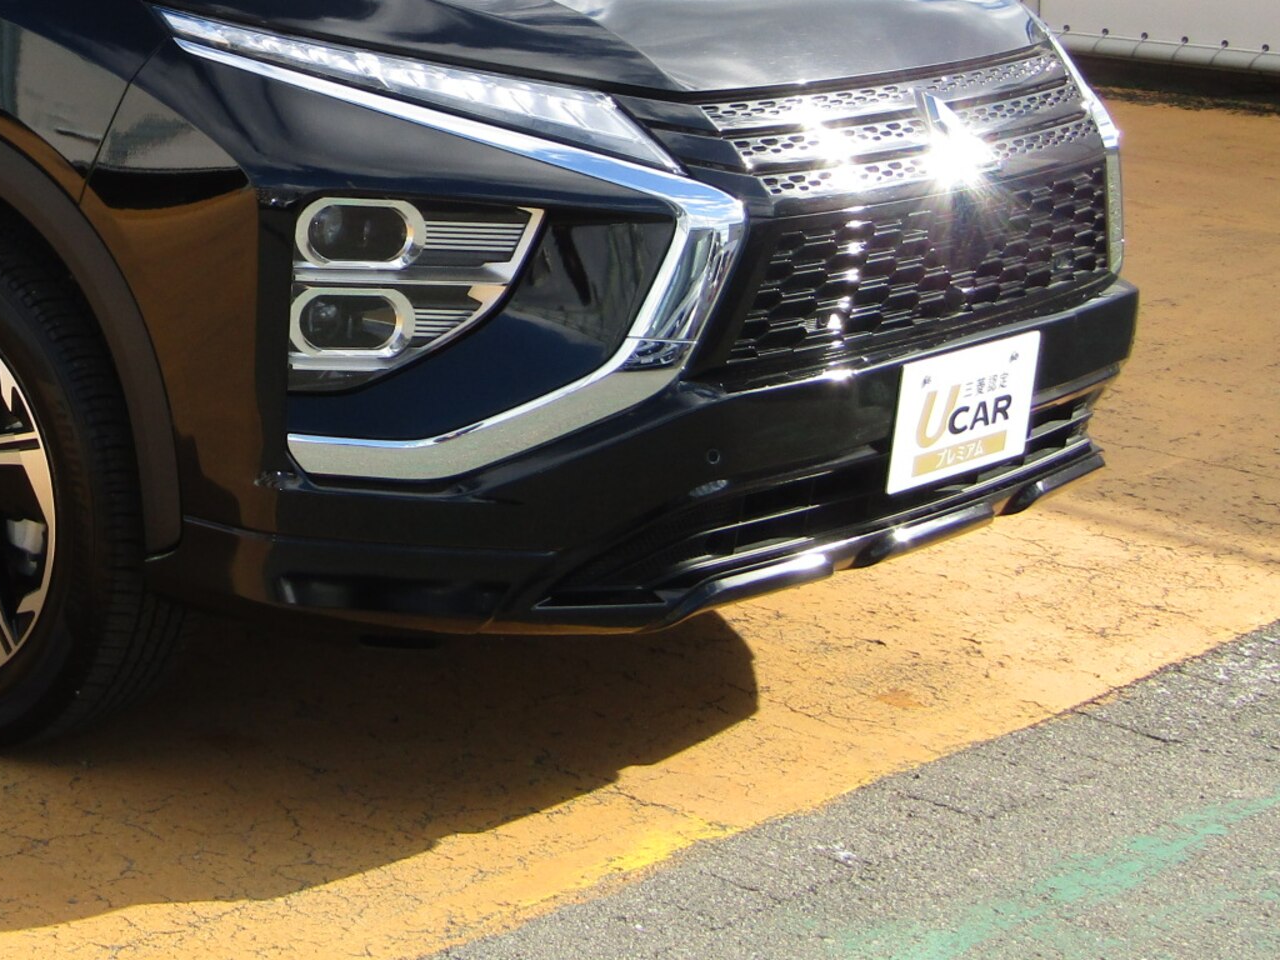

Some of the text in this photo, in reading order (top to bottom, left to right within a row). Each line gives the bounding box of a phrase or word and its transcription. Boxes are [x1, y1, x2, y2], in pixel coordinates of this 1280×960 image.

[935, 440, 985, 468] プレミアム
